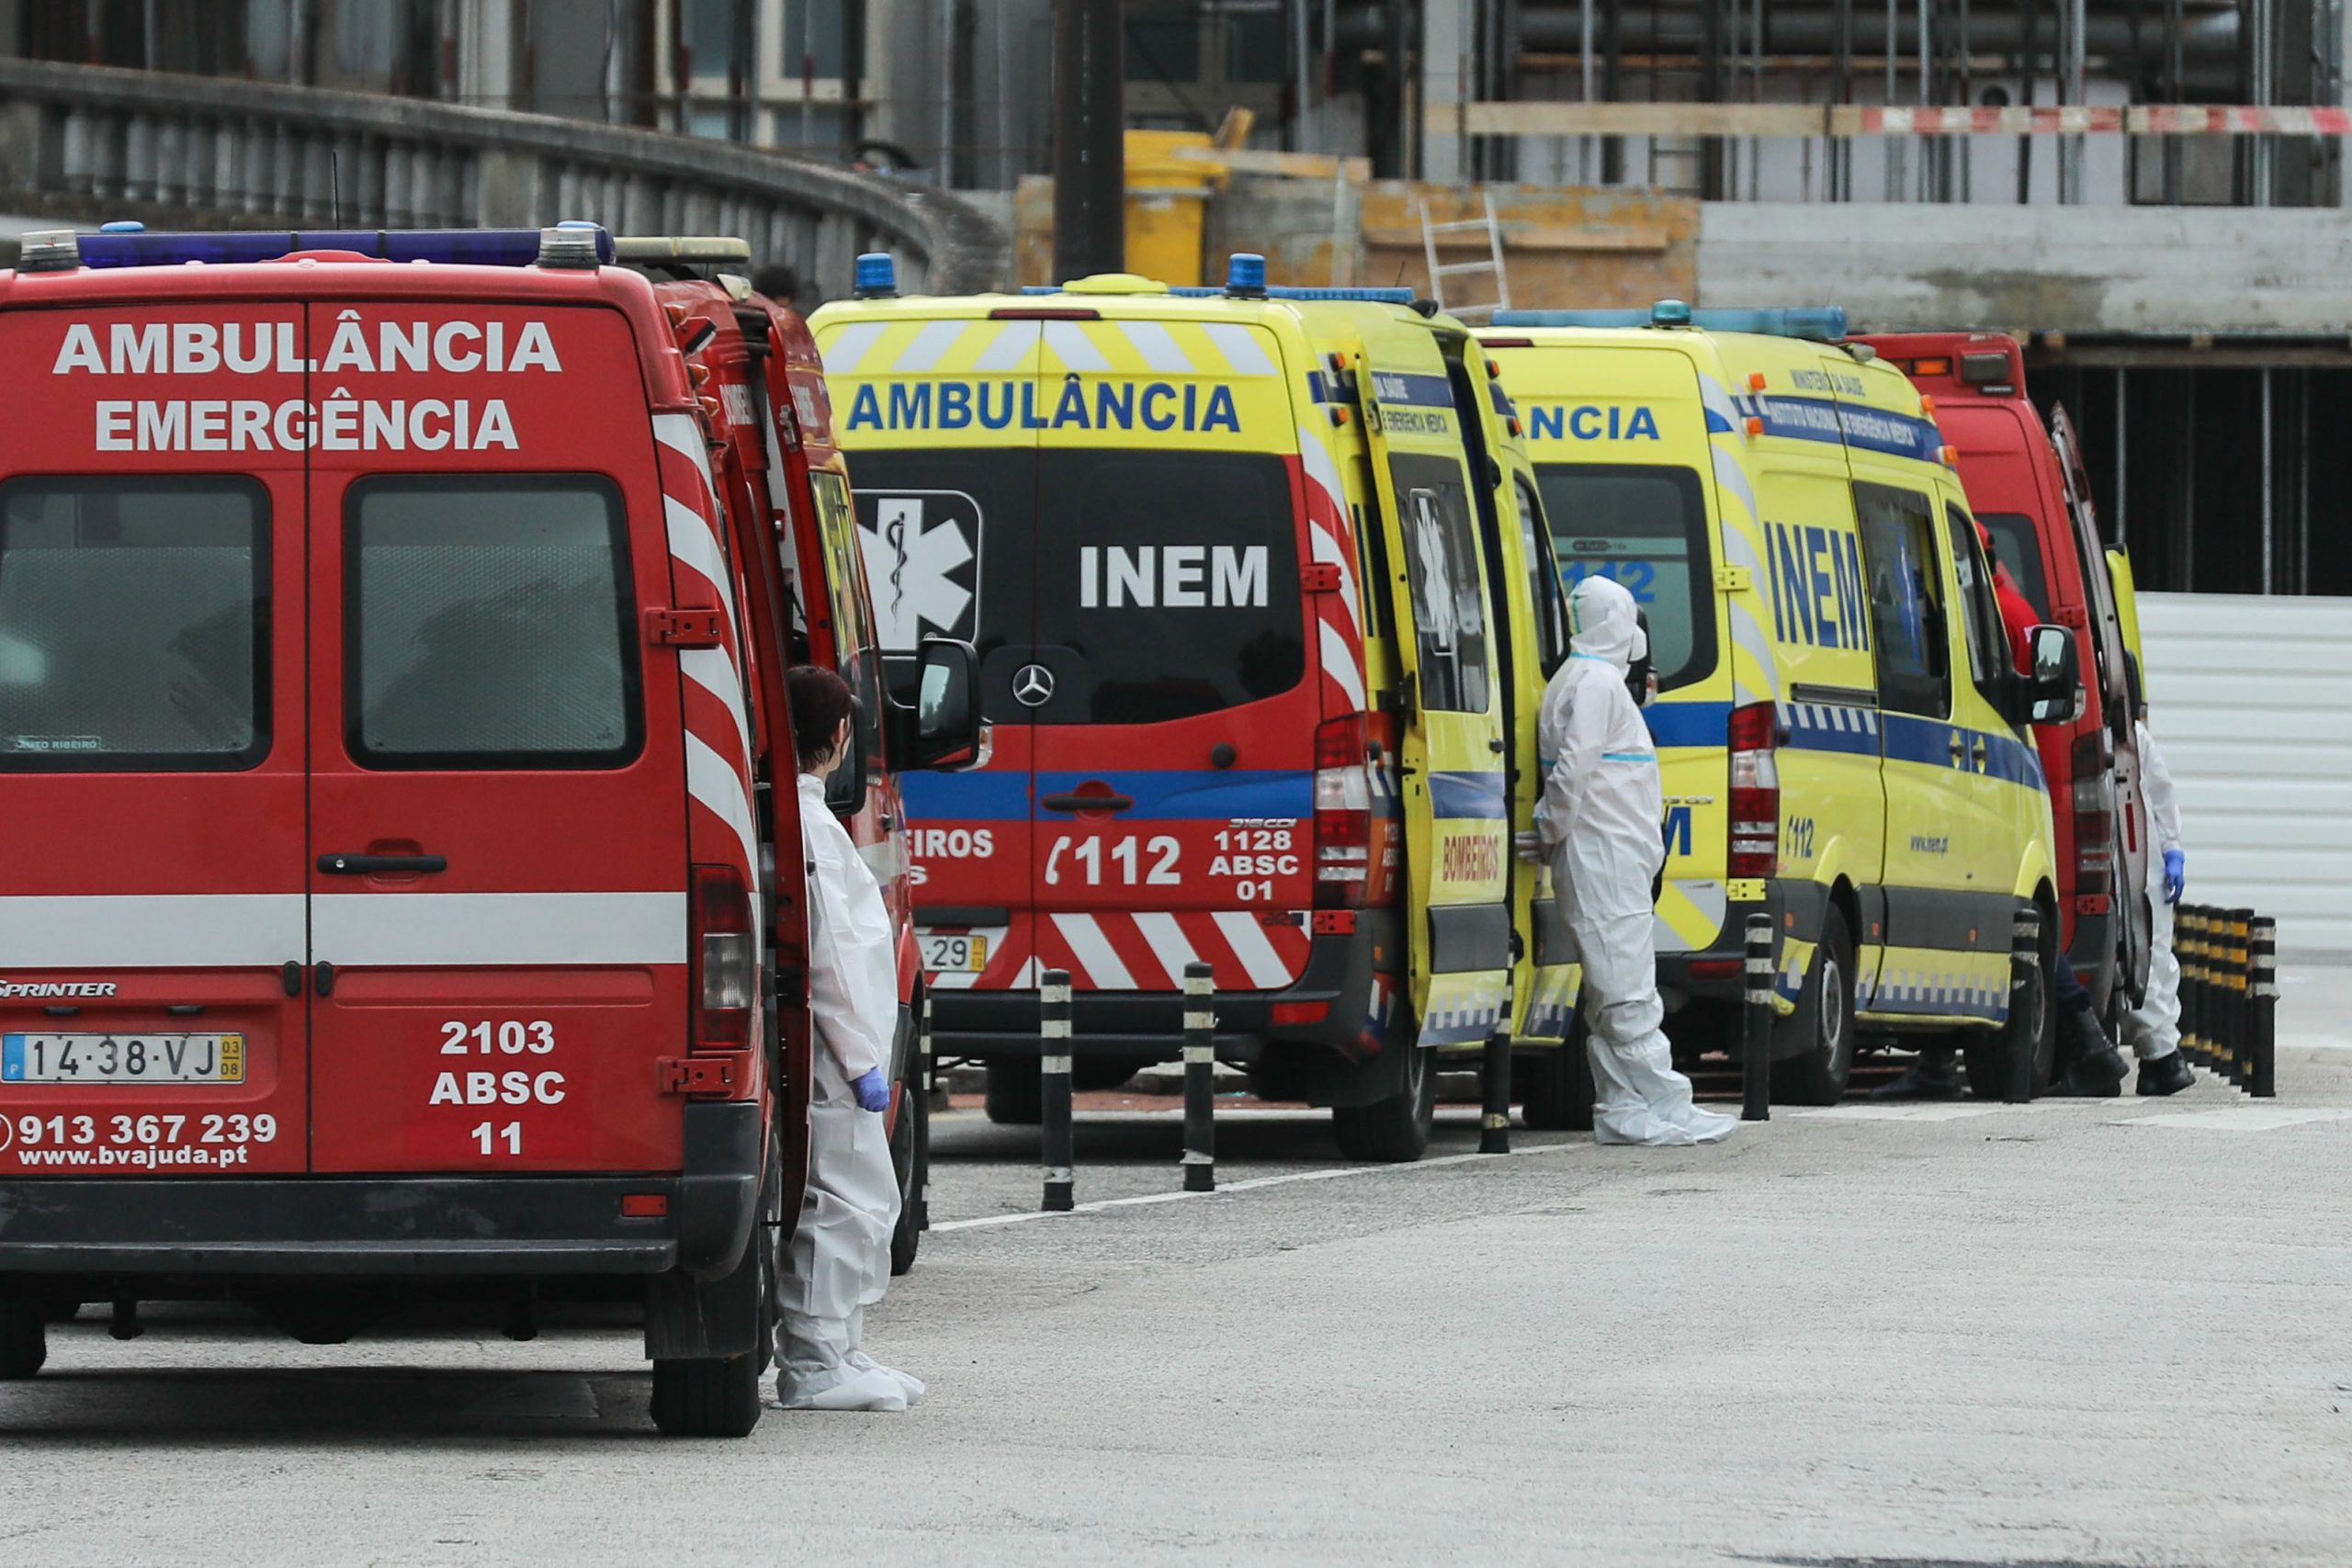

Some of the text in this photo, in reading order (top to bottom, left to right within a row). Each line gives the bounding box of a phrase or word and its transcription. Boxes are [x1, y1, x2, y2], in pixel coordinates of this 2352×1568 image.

[52, 310, 561, 374] AMBULÂNCIA
[96, 387, 519, 451] EMERGÊNCIA
[845, 373, 1240, 433] AMBULÂNCIA
[1080, 546, 1268, 608] INEM
[1764, 521, 1870, 651] INEM
[1214, 830, 1292, 851] 1128
[1075, 835, 1182, 886] 112
[1208, 855, 1298, 875] ABSC
[1442, 835, 1498, 882] BOMBEIROS
[1236, 880, 1272, 900] 01
[221, 1042, 240, 1054] 03
[440, 1021, 555, 1054] 2103
[220, 1063, 239, 1075] 08
[428, 1071, 565, 1104] ABSC
[18, 1114, 276, 1144] 913 367 239
[471, 1122, 521, 1155] 11
[18, 1145, 248, 1168] www.bvajuda.pt
